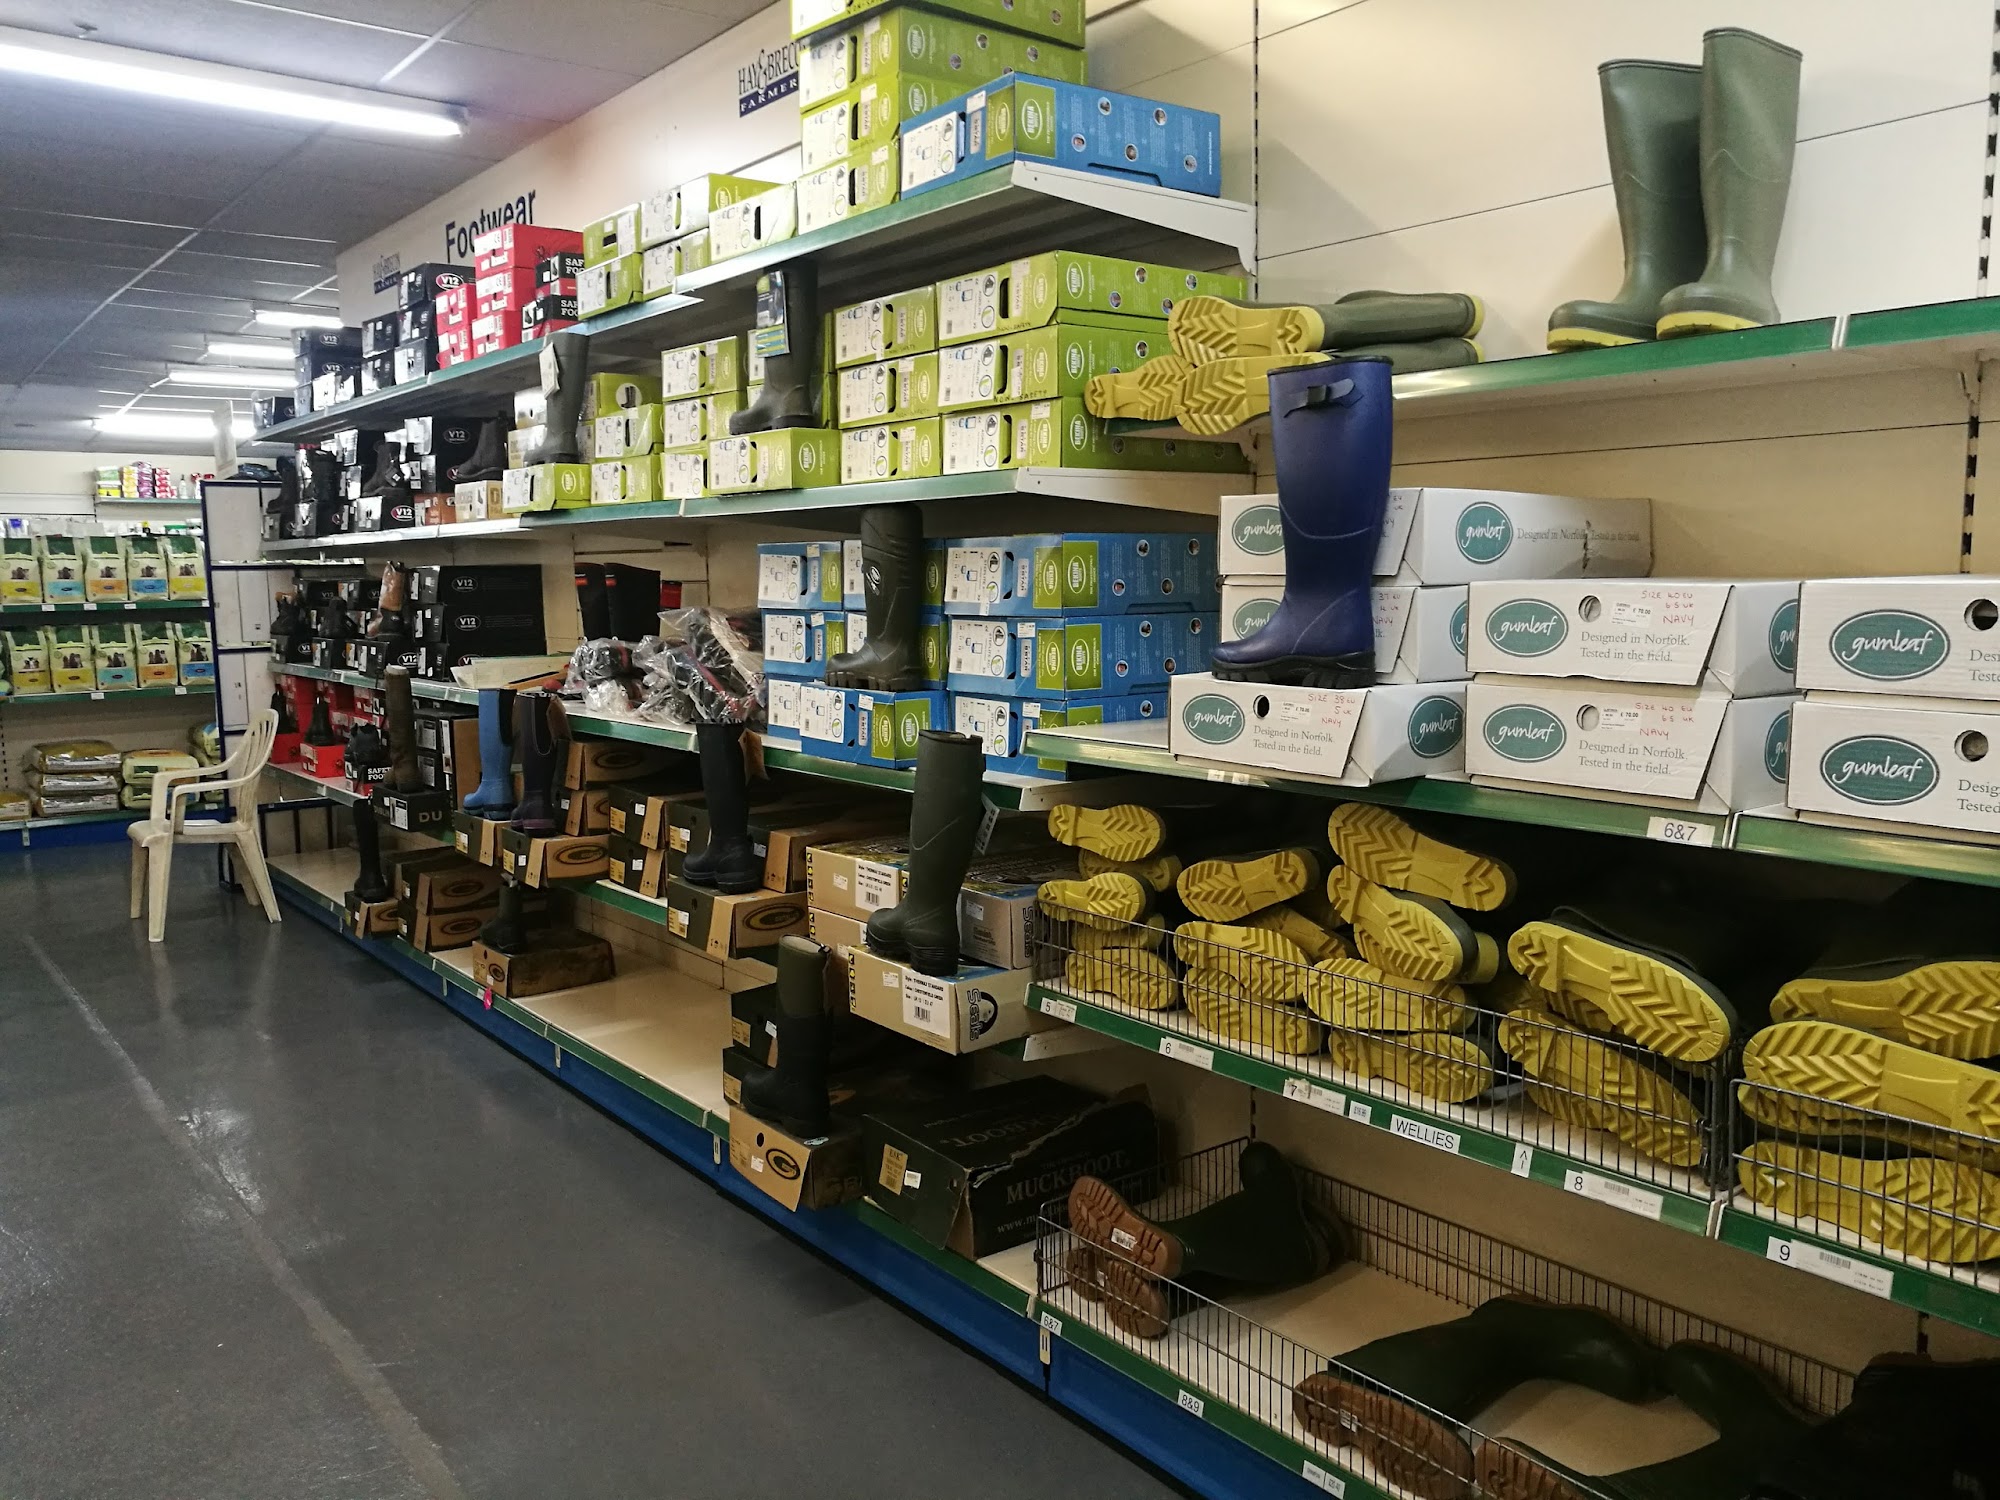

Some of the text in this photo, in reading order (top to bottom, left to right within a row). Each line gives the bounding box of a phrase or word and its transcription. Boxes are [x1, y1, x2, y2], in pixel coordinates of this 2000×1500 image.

[445, 189, 536, 263] Footwear
[442, 276, 459, 286] V12
[323, 335, 338, 343] V12
[396, 508, 412, 516] V12
[1462, 519, 1505, 548] gumleaf
[1641, 590, 1661, 599] SIZE
[460, 617, 476, 625] V12
[1499, 614, 1557, 642] gumleaf
[1663, 614, 1694, 626] NAVY
[1581, 631, 1690, 646] Designed in Norfolk.
[1841, 629, 1933, 662] gumleaf
[1580, 647, 1673, 662] Tested in the field.
[1308, 693, 1327, 702] SIZE
[1334, 694, 1345, 704] 38
[1635, 702, 1655, 710] SIZE
[1189, 708, 1237, 729] gumleaf
[1321, 717, 1341, 728] NAVY
[1254, 725, 1288, 738] Designed
[1291, 729, 1298, 738] in
[1419, 714, 1458, 742] gumleaf
[1497, 721, 1554, 749] gumleaf
[1640, 728, 1669, 740] NAVY
[1253, 739, 1323, 756] Tested in the field.
[1578, 739, 1688, 760] Designed in Norfolk.
[1578, 755, 1671, 775] Tested in the field.
[1832, 756, 1924, 785] gumleaf
[1664, 822, 1697, 841] 6&7
[967, 987, 982, 1042] Seals
[1045, 1001, 1051, 1012] 5
[1165, 1042, 1172, 1055] 6
[1290, 1084, 1298, 1097] 7
[1395, 1118, 1454, 1150] WELLIES
[1006, 1150, 1126, 1204] MUCKBOOT
[1574, 1175, 1583, 1191] 8
[1780, 1244, 1790, 1261] 9
[1043, 1315, 1059, 1331] 6&7
[1181, 1394, 1200, 1413] 8&9
